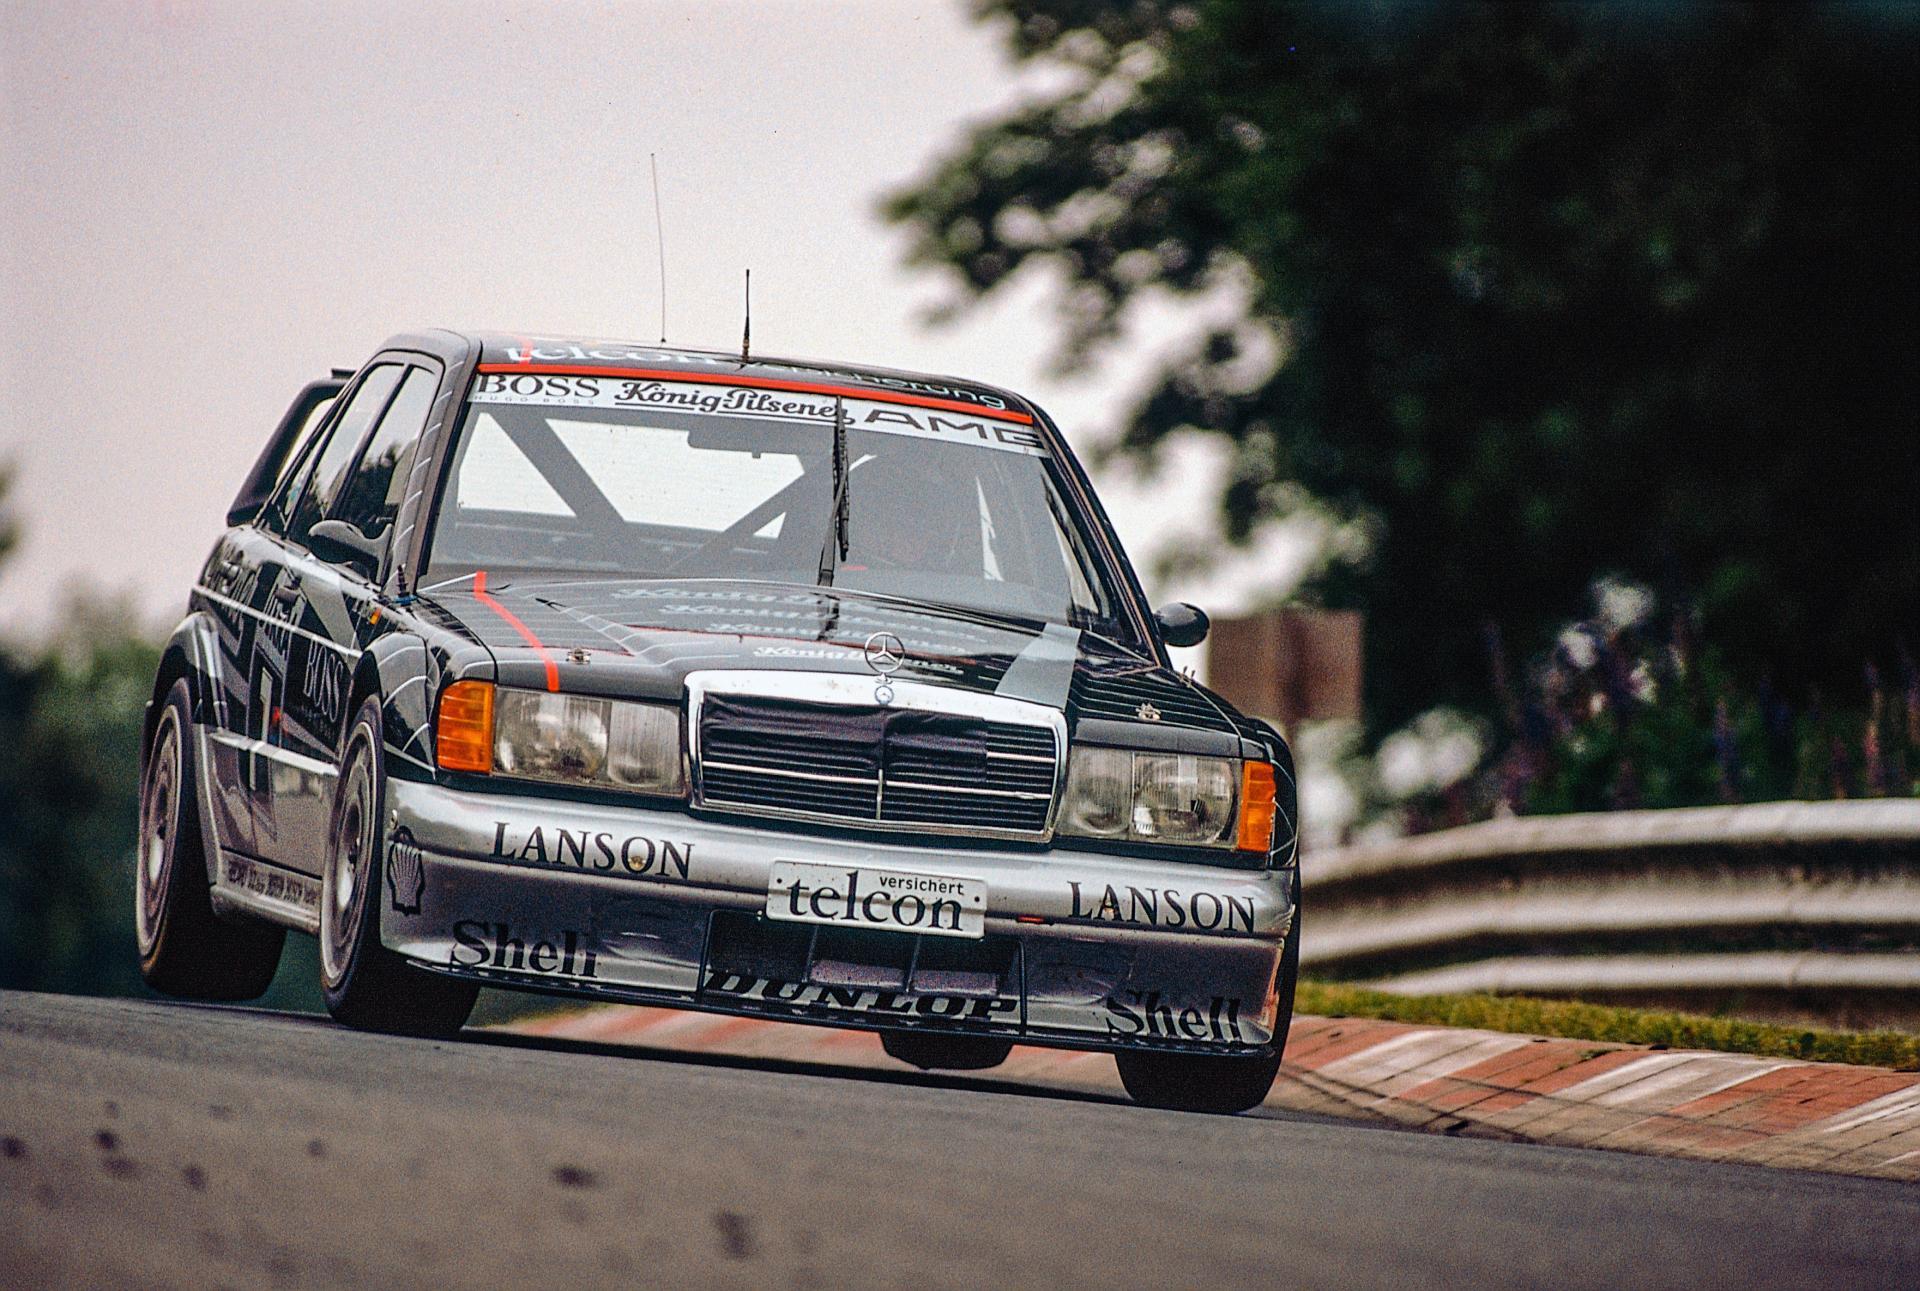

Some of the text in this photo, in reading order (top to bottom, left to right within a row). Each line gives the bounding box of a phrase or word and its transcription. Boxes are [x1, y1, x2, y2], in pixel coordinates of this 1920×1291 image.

[477, 374, 600, 398] BOSS
[304, 638, 344, 723] BOSS
[489, 821, 695, 879] LANSON
[786, 869, 963, 931] telcon
[879, 874, 965, 896] versichert
[1066, 880, 1255, 933] LANSON
[450, 919, 598, 978] Shell
[702, 971, 1018, 1022] DUNLOP
[1105, 990, 1242, 1042] Shell
